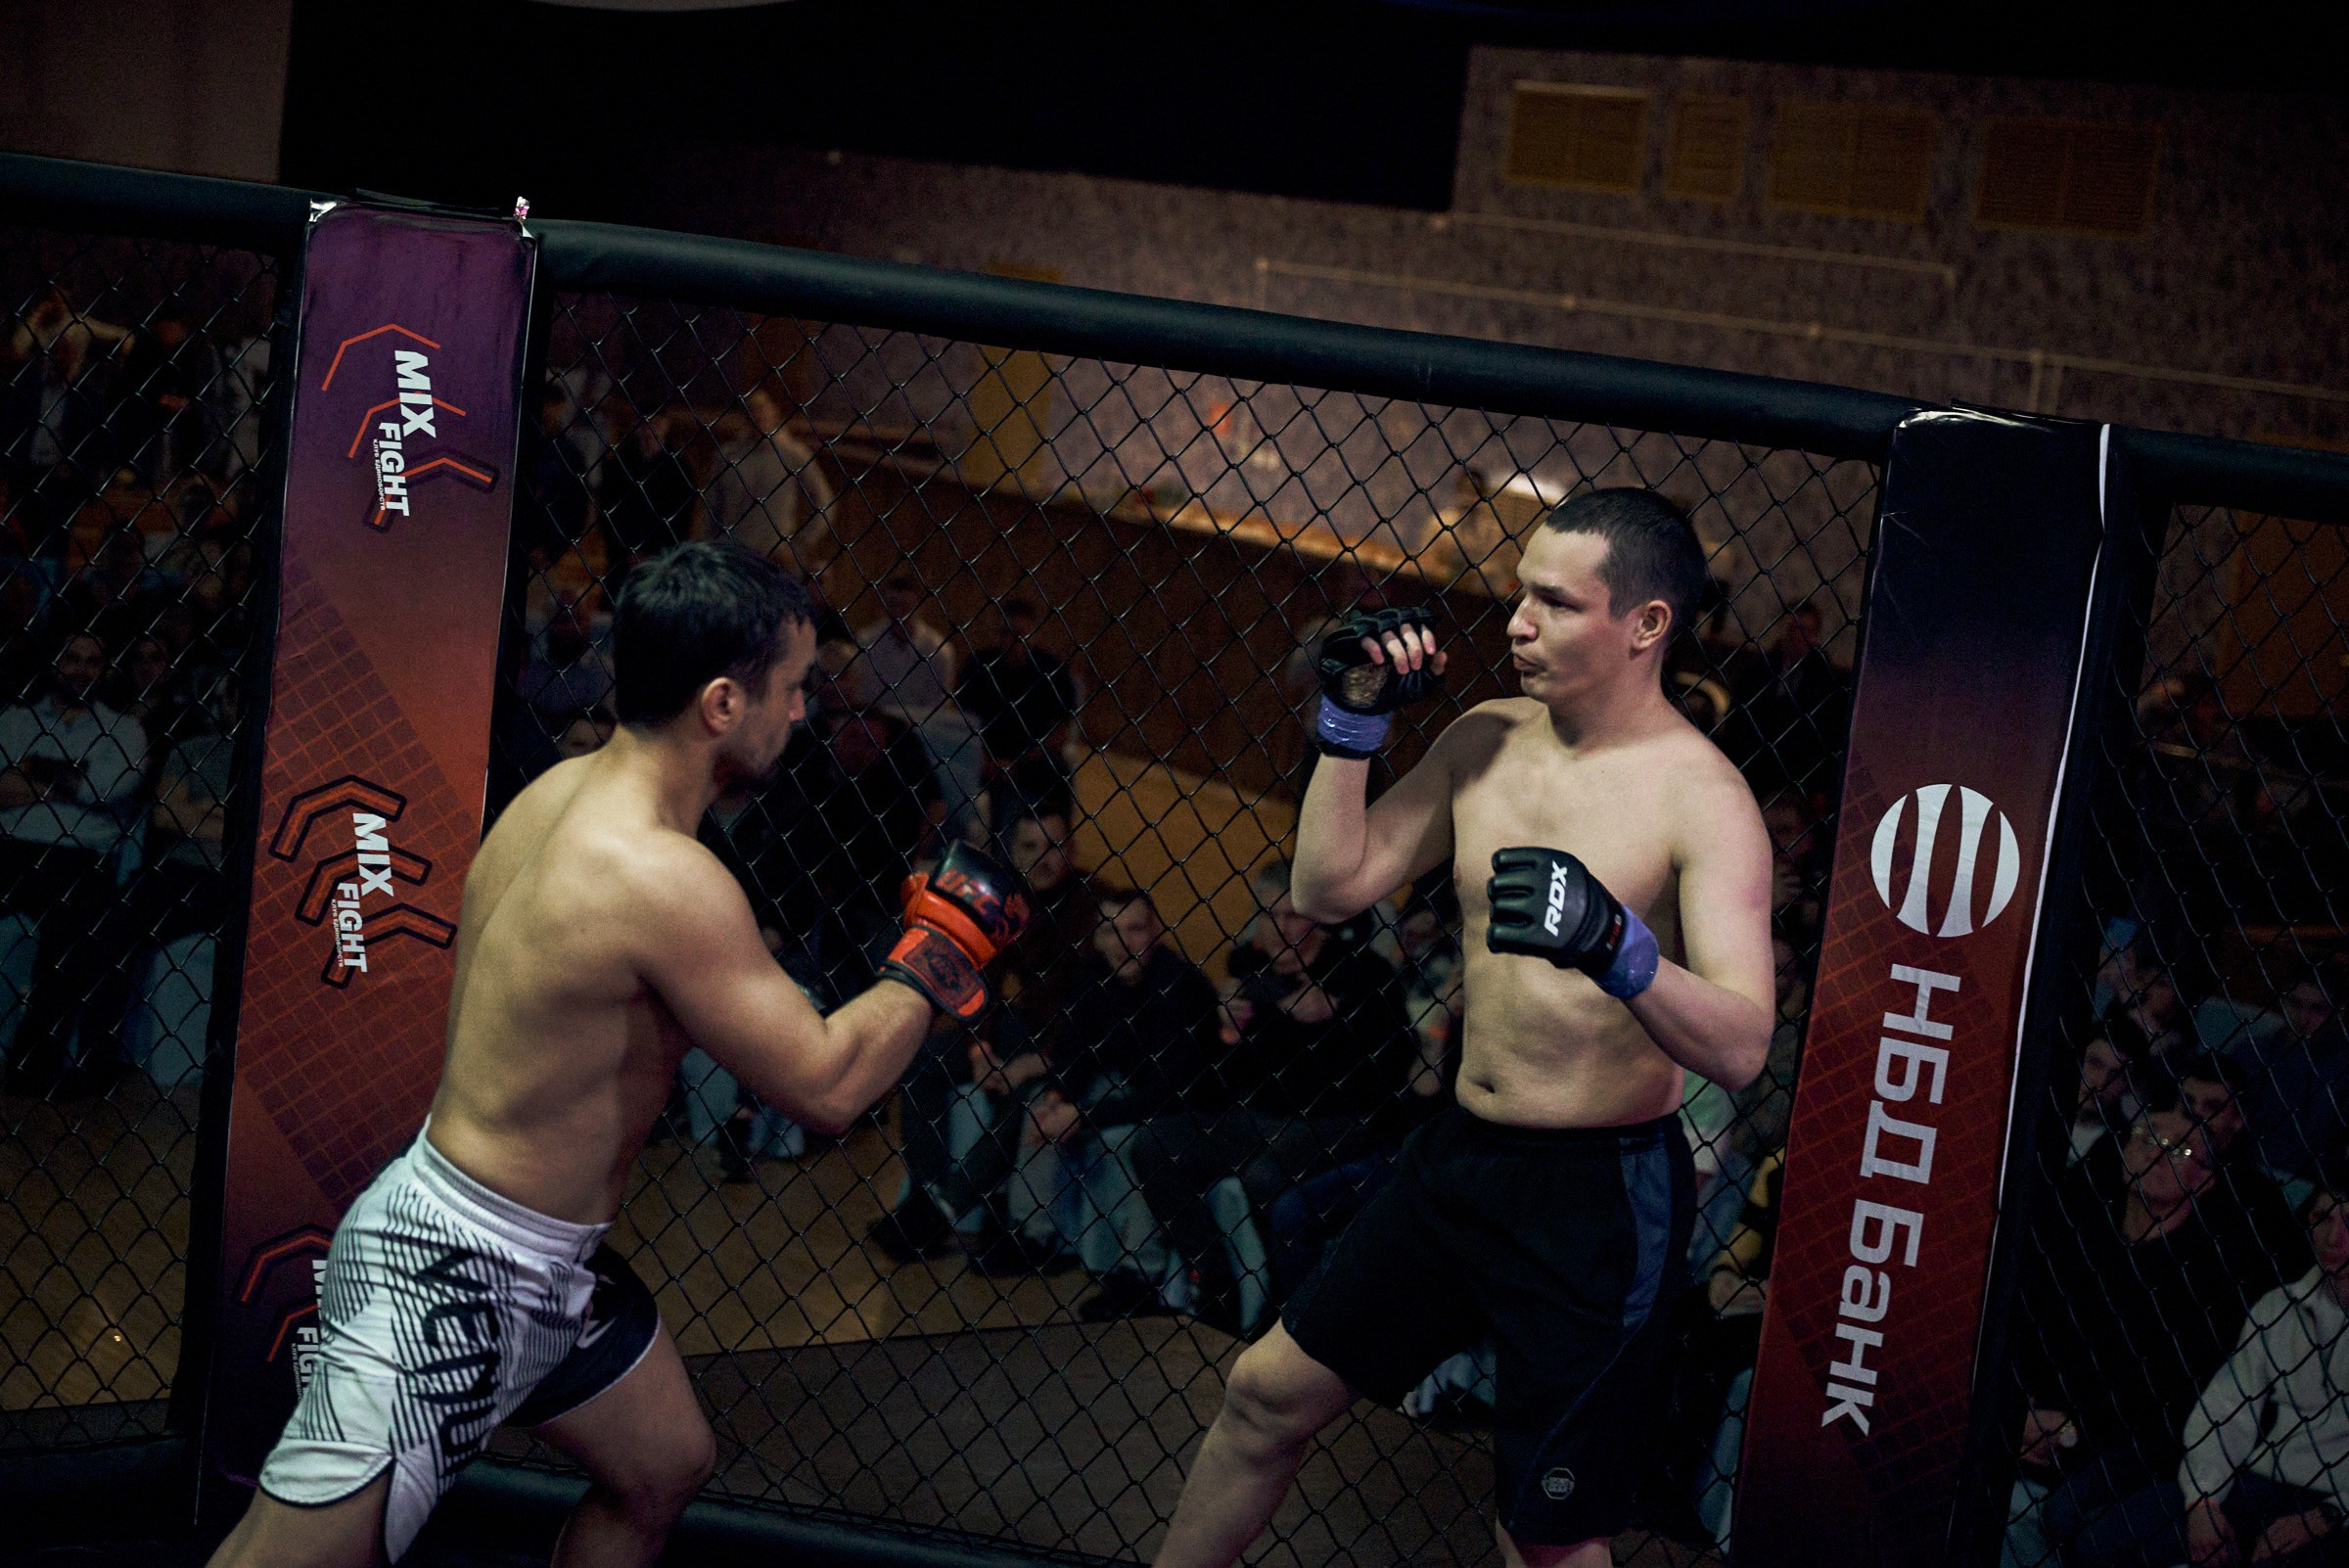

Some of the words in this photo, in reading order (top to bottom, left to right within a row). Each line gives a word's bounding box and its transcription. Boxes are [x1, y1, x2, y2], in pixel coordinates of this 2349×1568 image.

[393, 349, 437, 438] MIX
[378, 422, 410, 517] FIGHT
[352, 812, 394, 898] MIX
[934, 869, 1001, 916] UFC
[1543, 860, 1568, 938] RDX
[337, 882, 368, 973] FIGHT
[1860, 962, 1961, 1186] НБД
[296, 1326, 321, 1388] FIG
[409, 1249, 502, 1476] VENU
[1820, 1198, 1924, 1438] Банк
